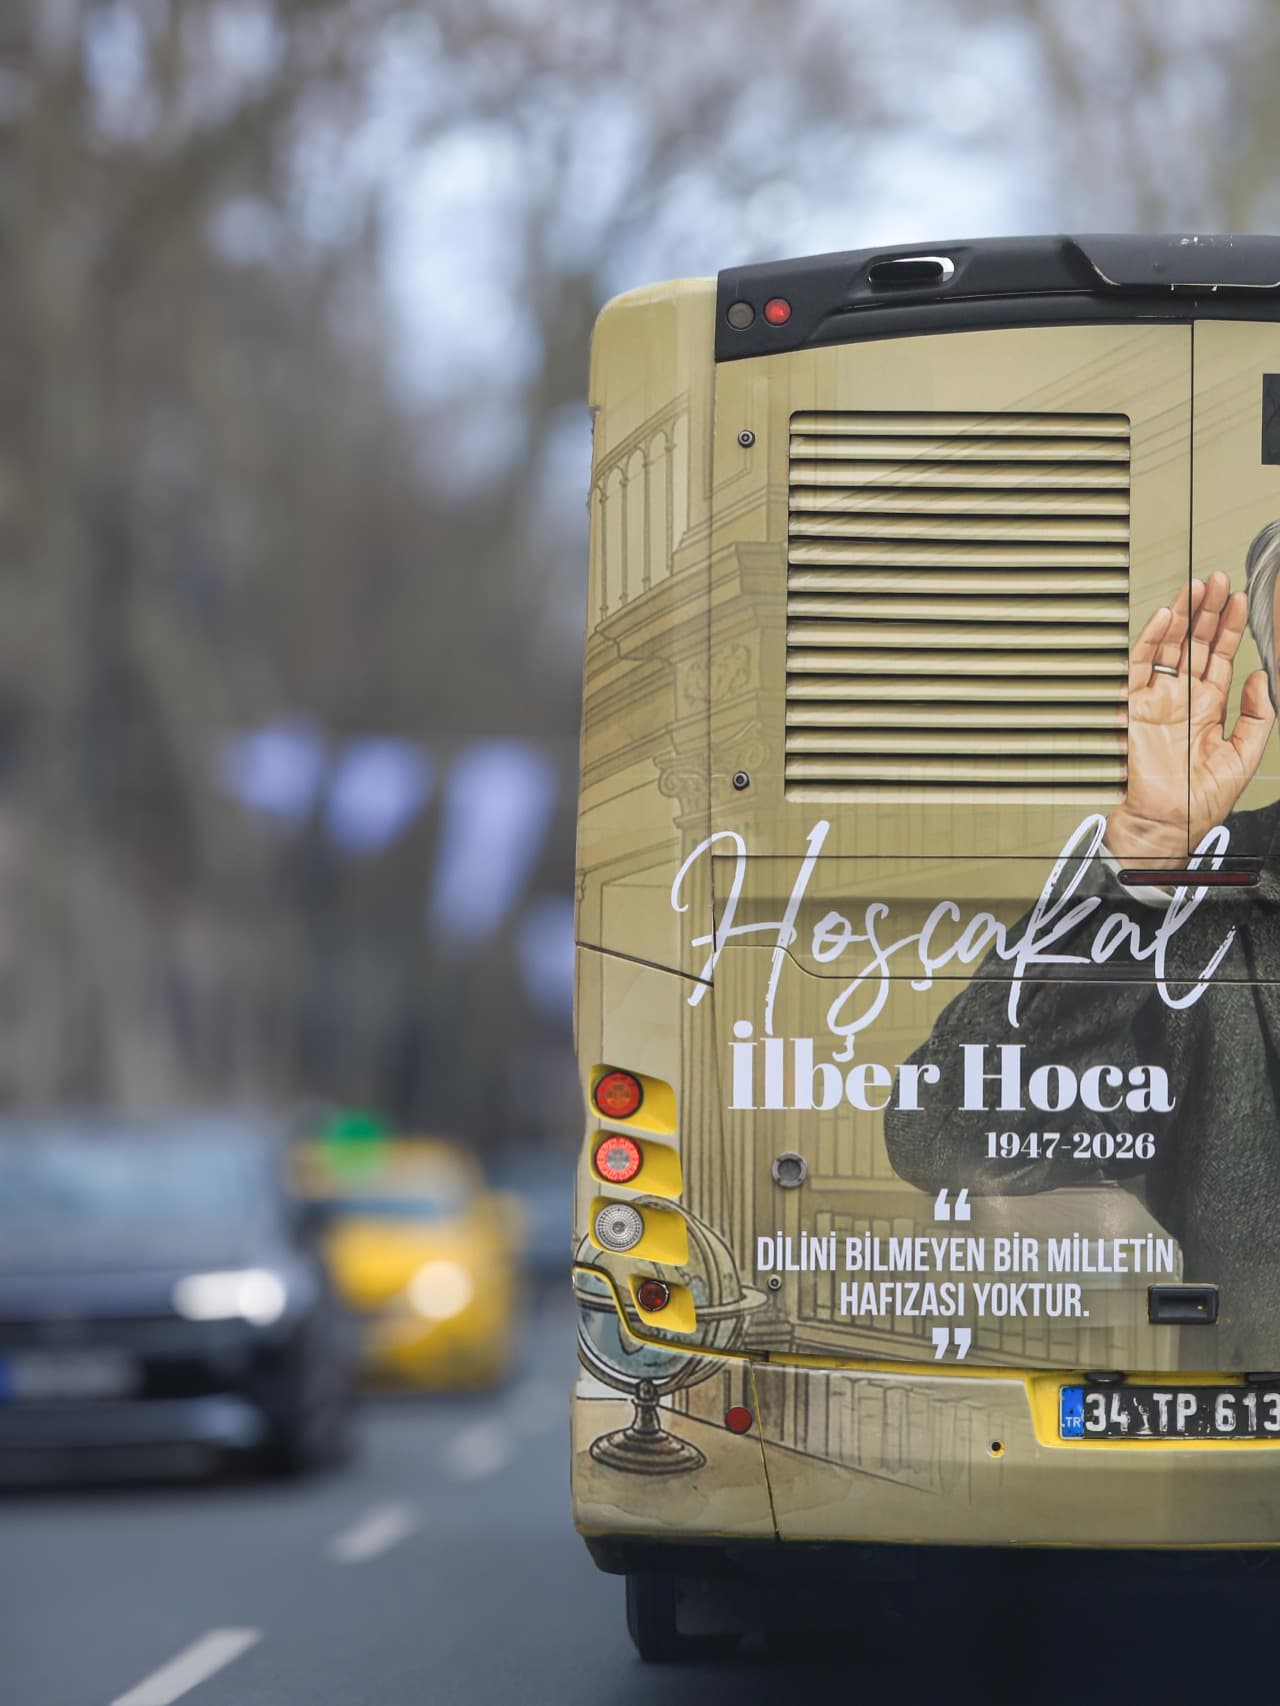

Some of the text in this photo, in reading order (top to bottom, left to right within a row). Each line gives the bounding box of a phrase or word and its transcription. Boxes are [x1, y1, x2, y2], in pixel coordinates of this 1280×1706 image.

[670, 813, 1238, 1062] Hoşçakal
[728, 1020, 1176, 1112] İlber Hoca
[984, 1131, 1156, 1160] 1947-2026
[757, 1231, 1174, 1273] DİLİNİ BİLMEYEN BİR MİLLETİN
[840, 1282, 1090, 1317] HAFIZASI YOKTUR.
[1065, 1416, 1081, 1428] TR
[1085, 1392, 1130, 1432] 34
[1152, 1392, 1198, 1432] TP
